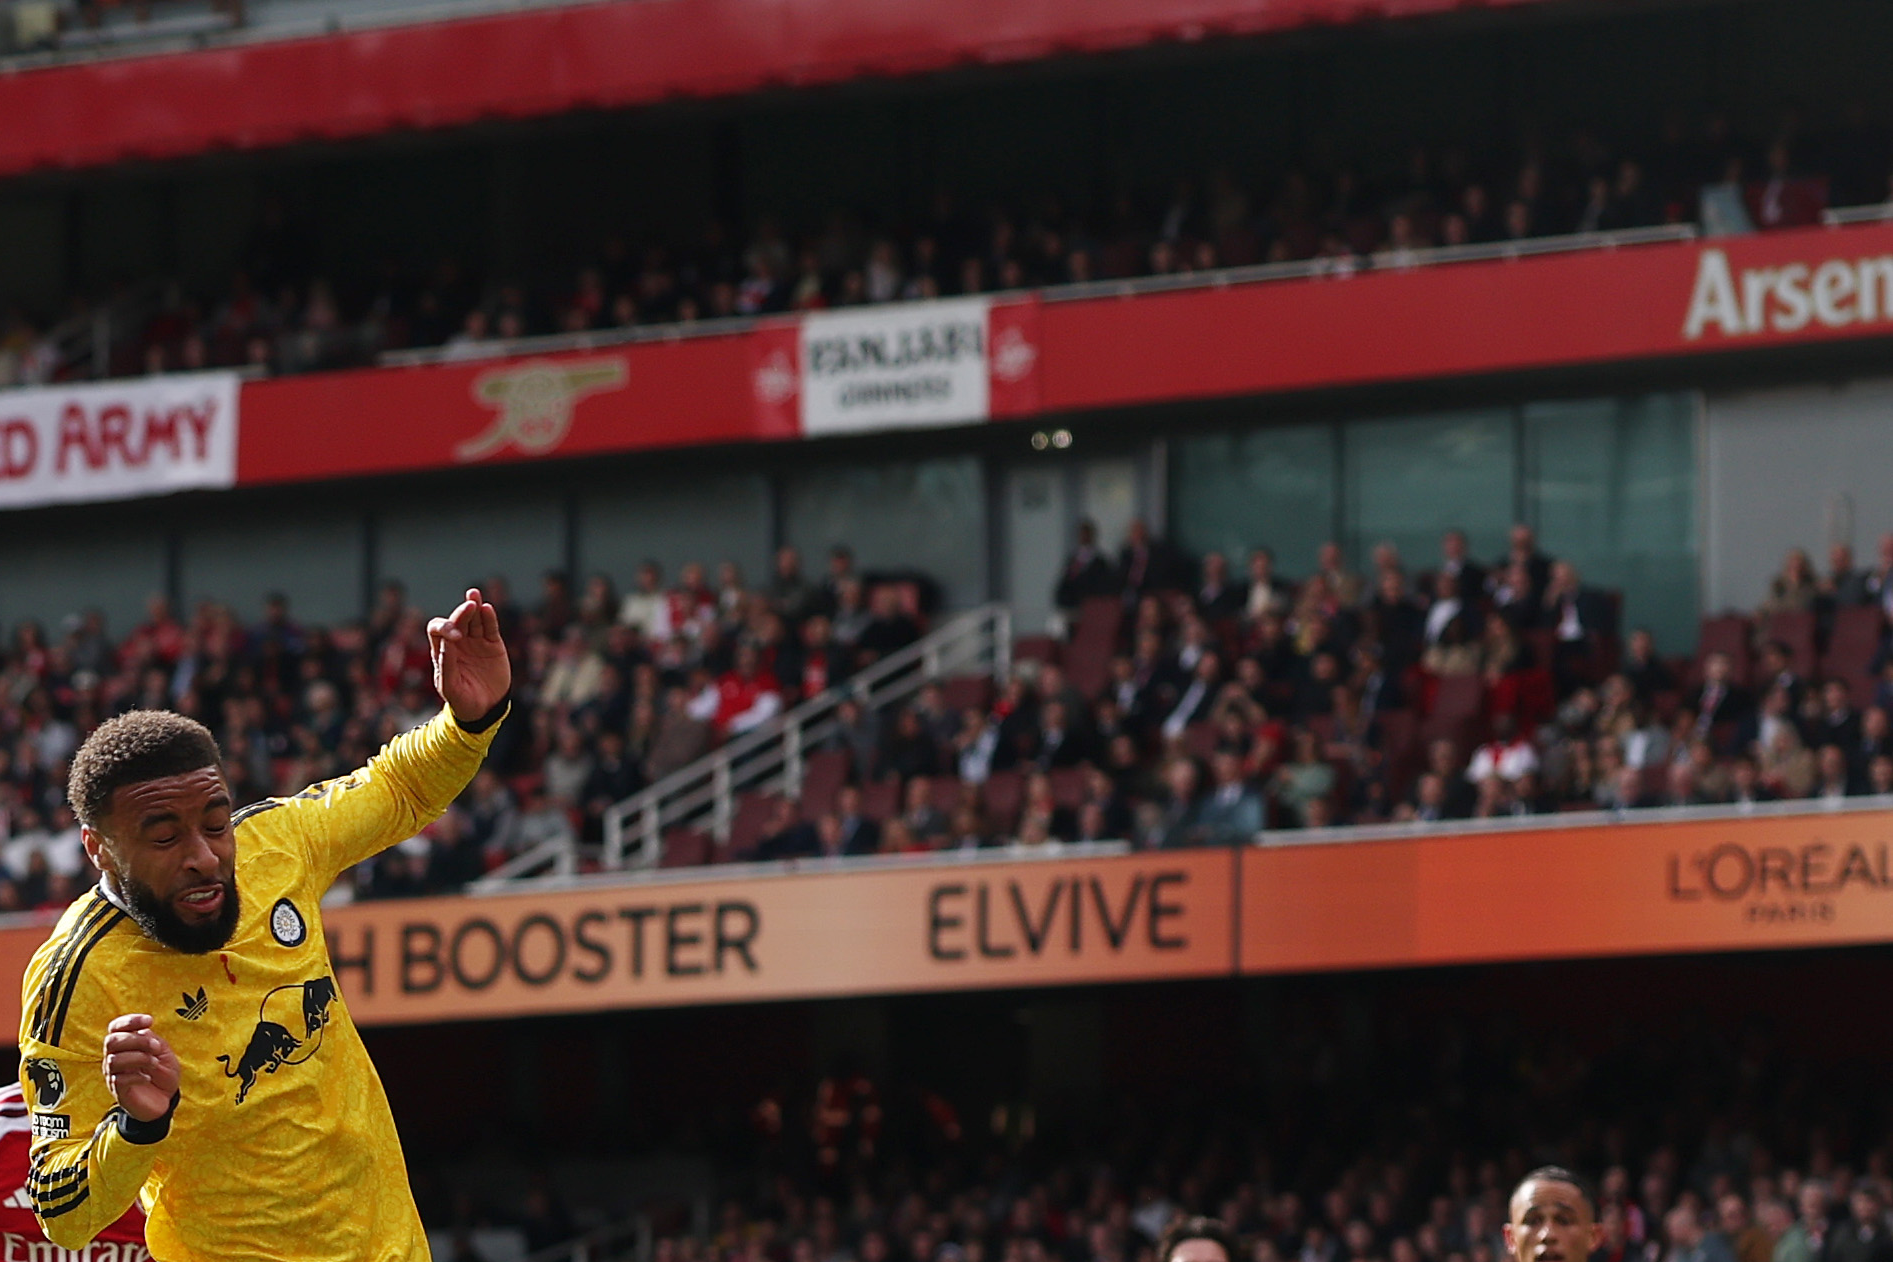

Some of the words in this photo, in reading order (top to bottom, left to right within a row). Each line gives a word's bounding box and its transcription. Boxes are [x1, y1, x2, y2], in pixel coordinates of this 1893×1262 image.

[1683, 247, 1893, 341] Arsen
[54, 397, 218, 479] ARMY
[401, 902, 760, 994] BOOSTER
[928, 871, 1187, 962] ELVIVE
